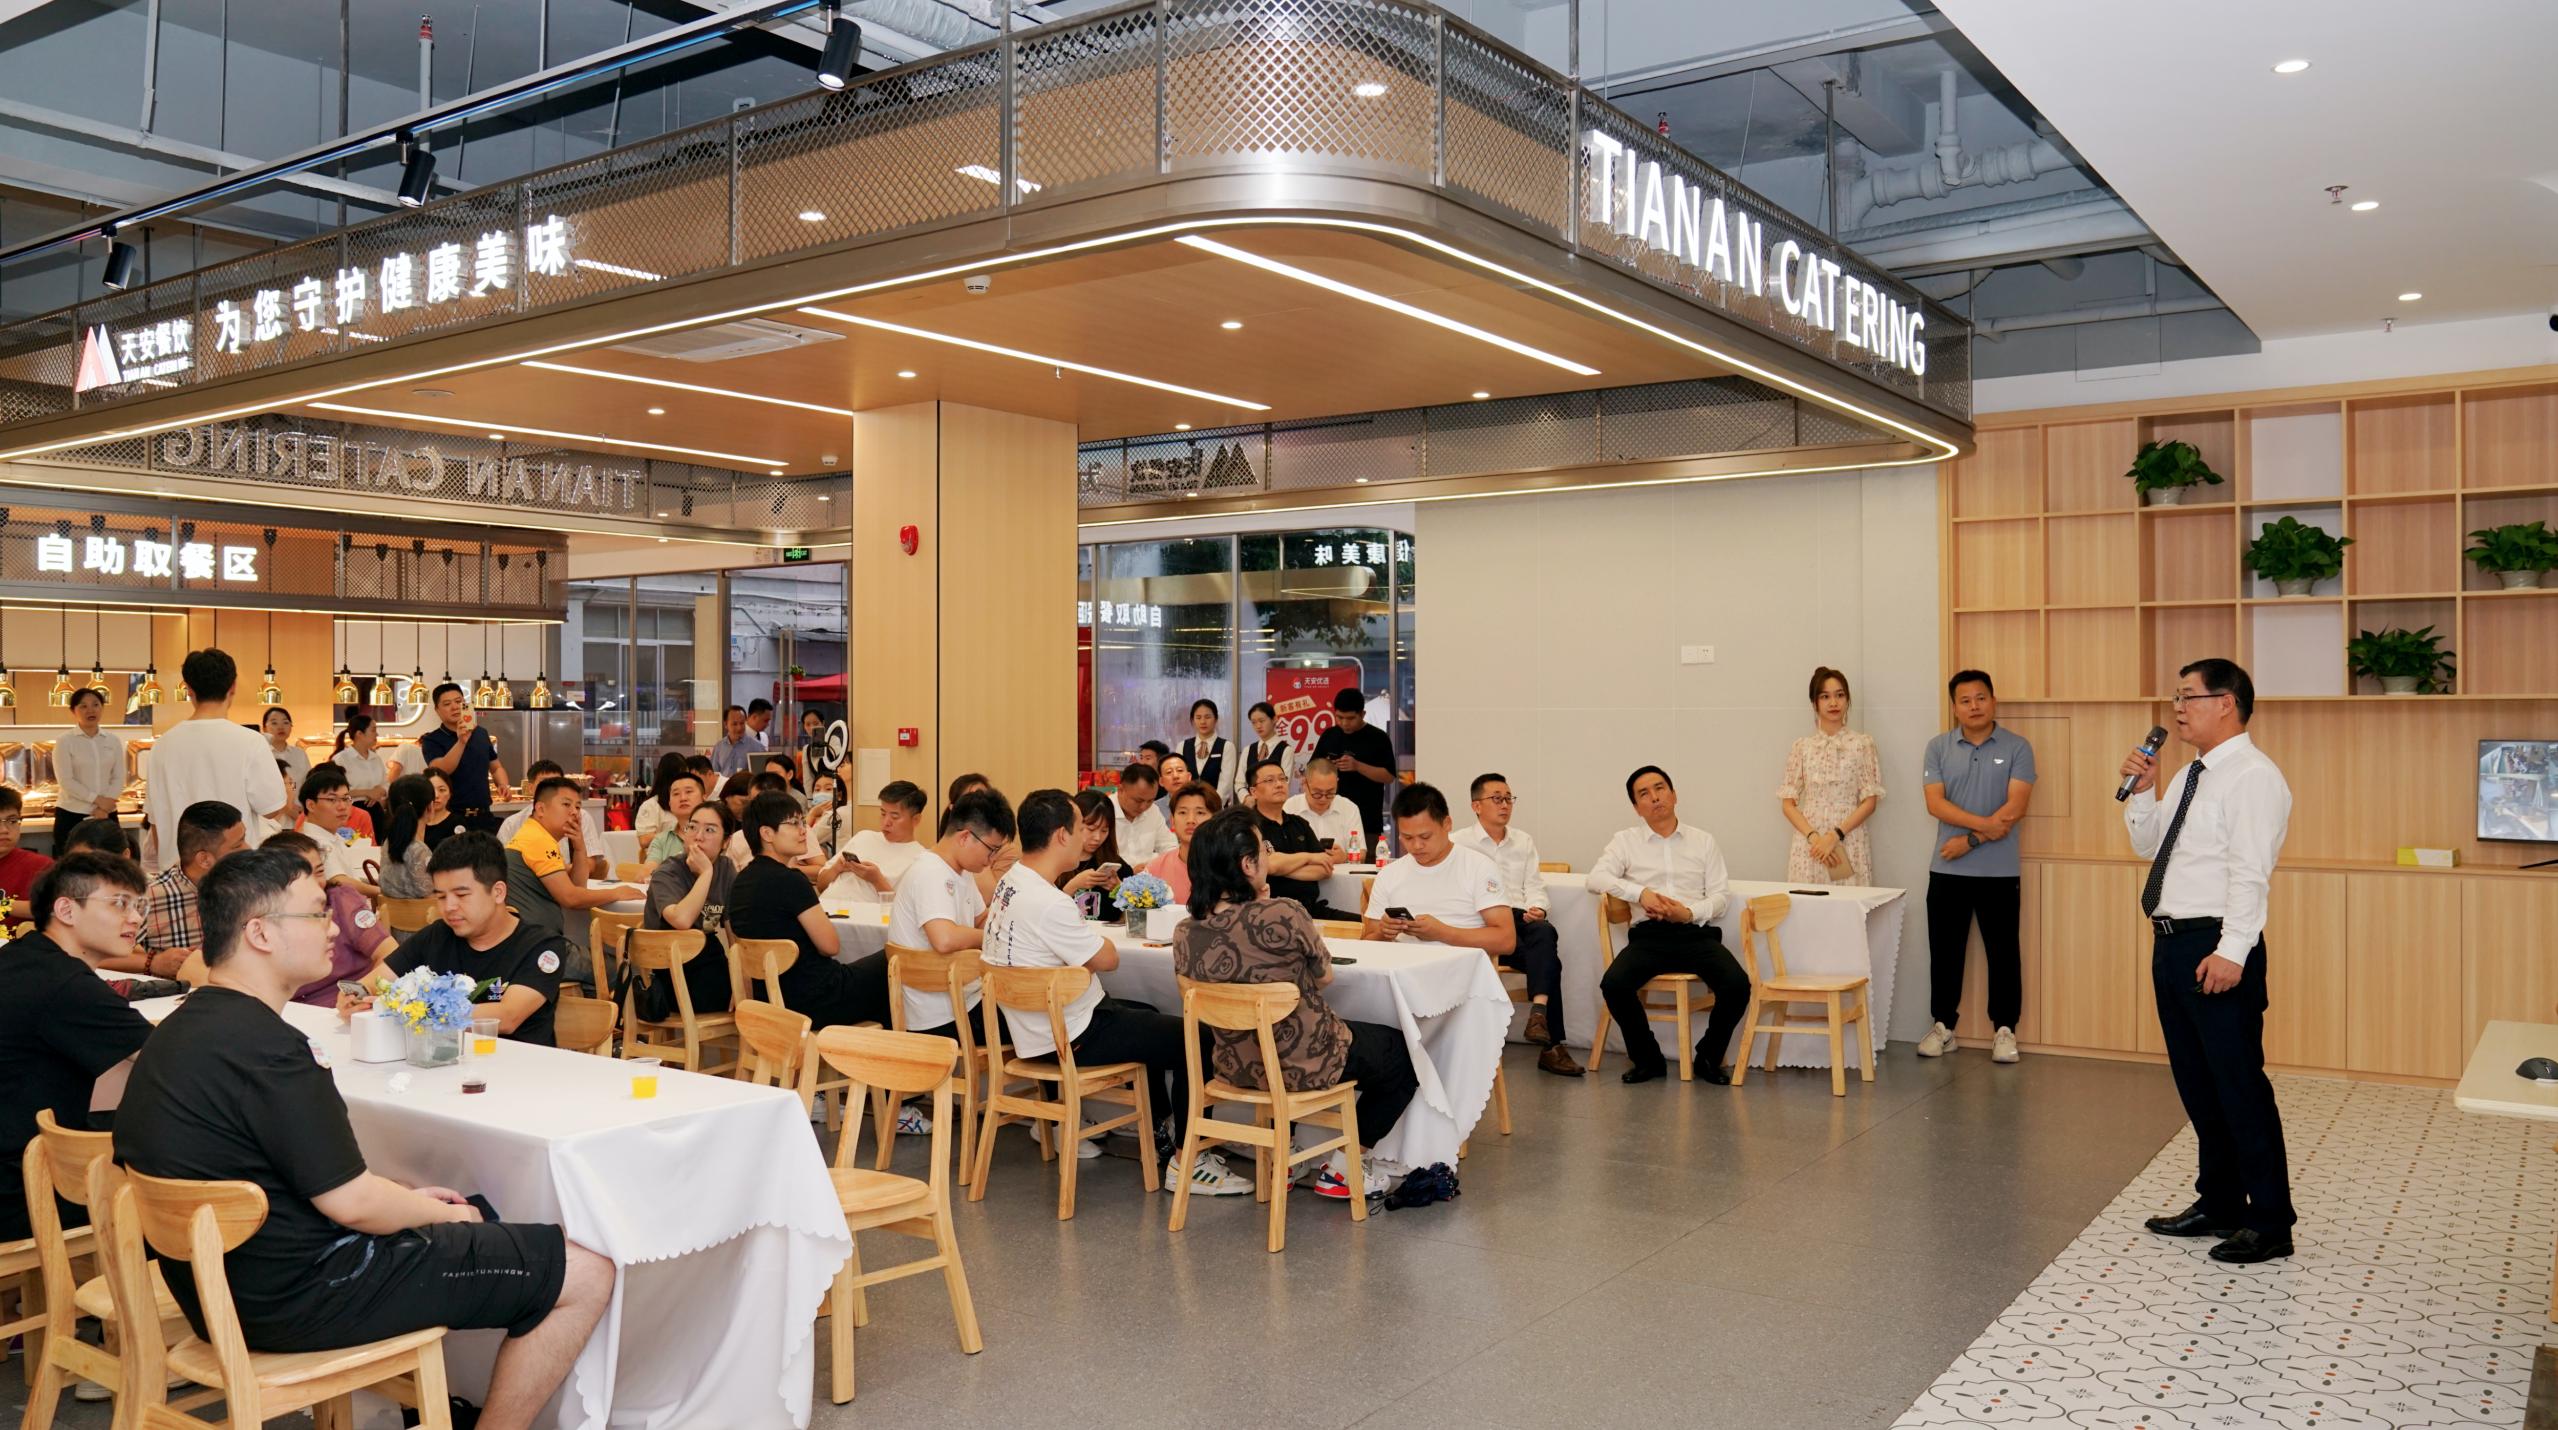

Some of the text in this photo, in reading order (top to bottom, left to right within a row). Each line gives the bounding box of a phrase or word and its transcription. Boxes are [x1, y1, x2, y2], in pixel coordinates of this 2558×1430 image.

[215, 214, 570, 354] 为您守护健康美味
[1588, 129, 1925, 376] TIANAN CATERING
[36, 533, 258, 582] 自助取餐区
